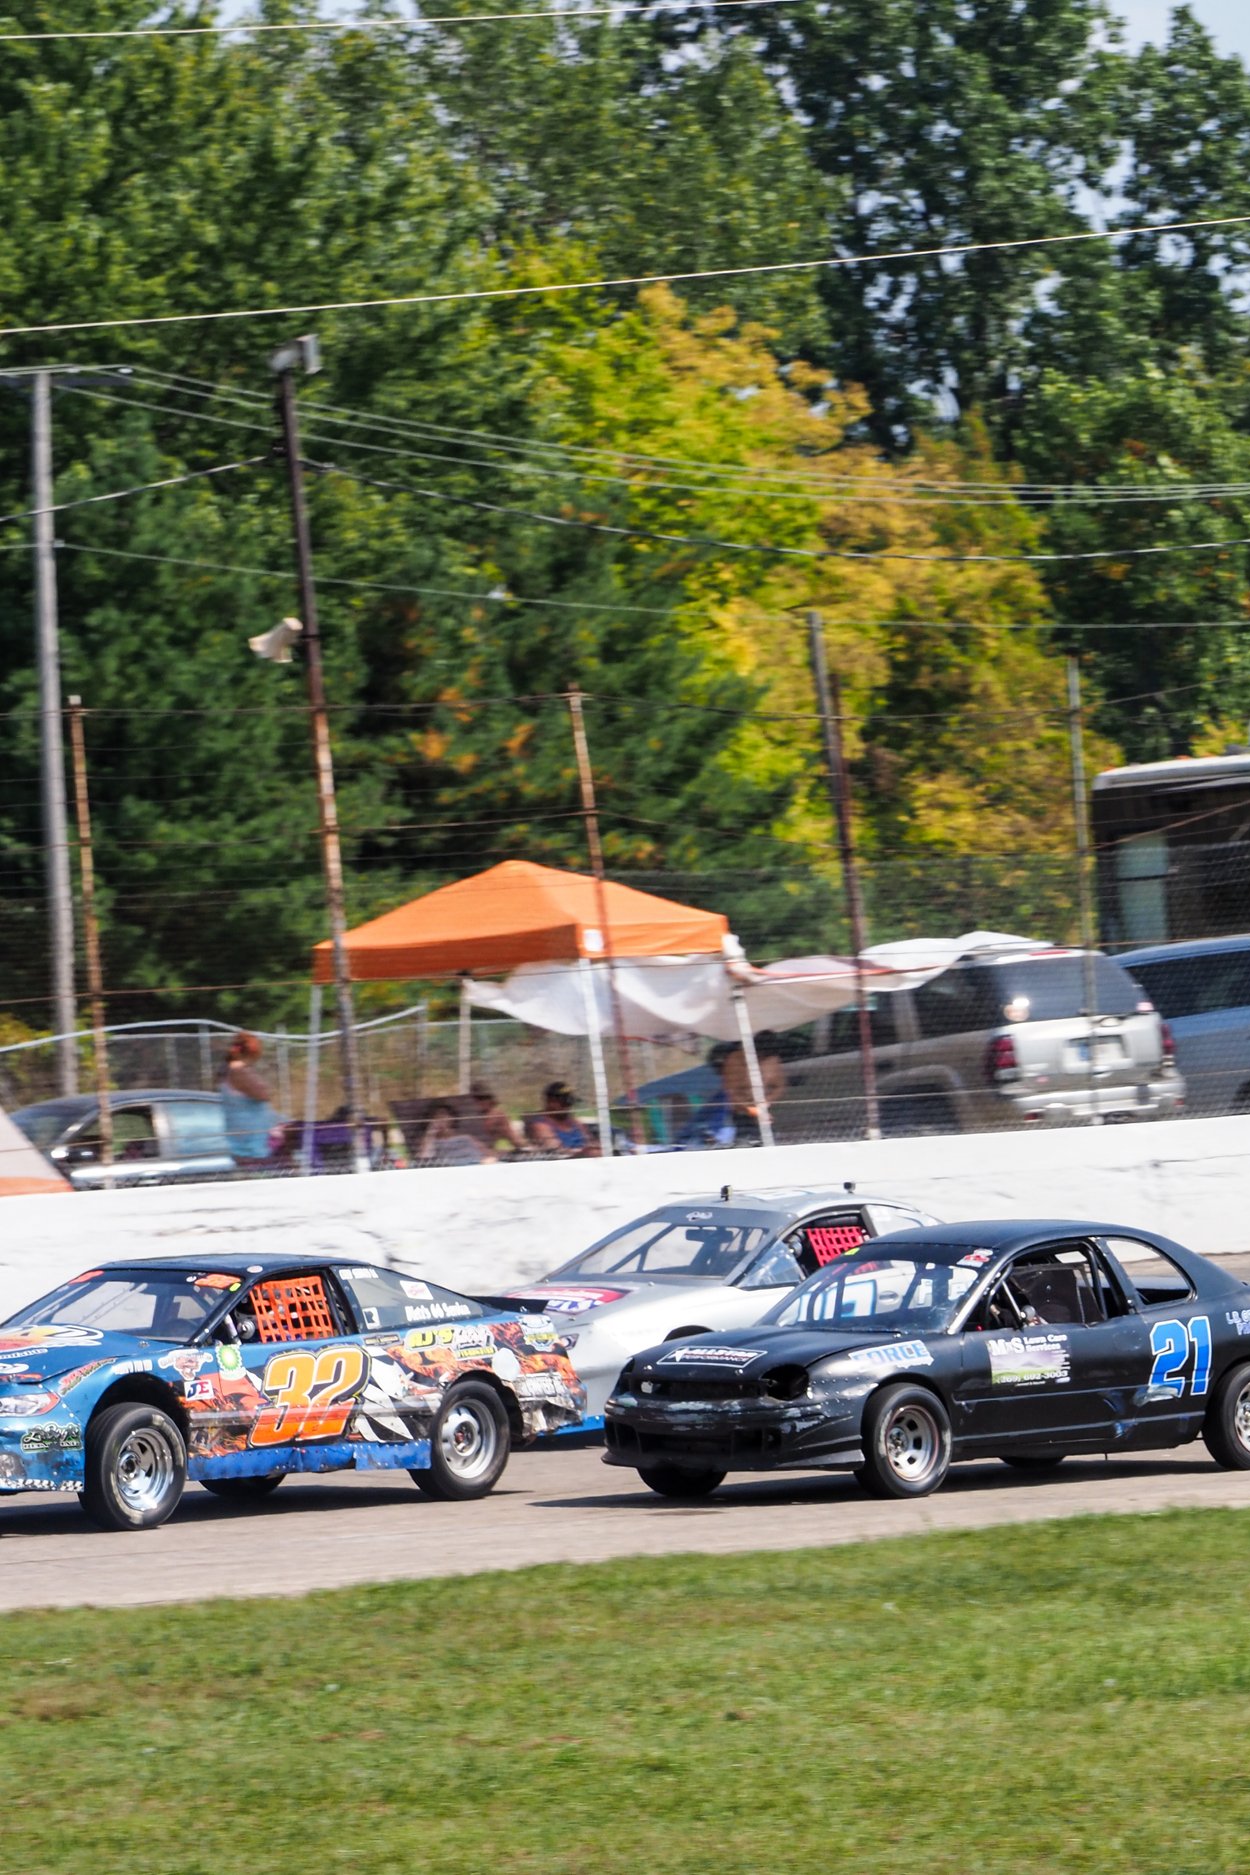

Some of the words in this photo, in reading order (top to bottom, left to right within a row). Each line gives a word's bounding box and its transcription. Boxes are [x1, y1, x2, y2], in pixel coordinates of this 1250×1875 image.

[852, 1341, 930, 1364] FORCE
[1148, 1315, 1213, 1398] 21
[248, 1344, 372, 1448] 32
